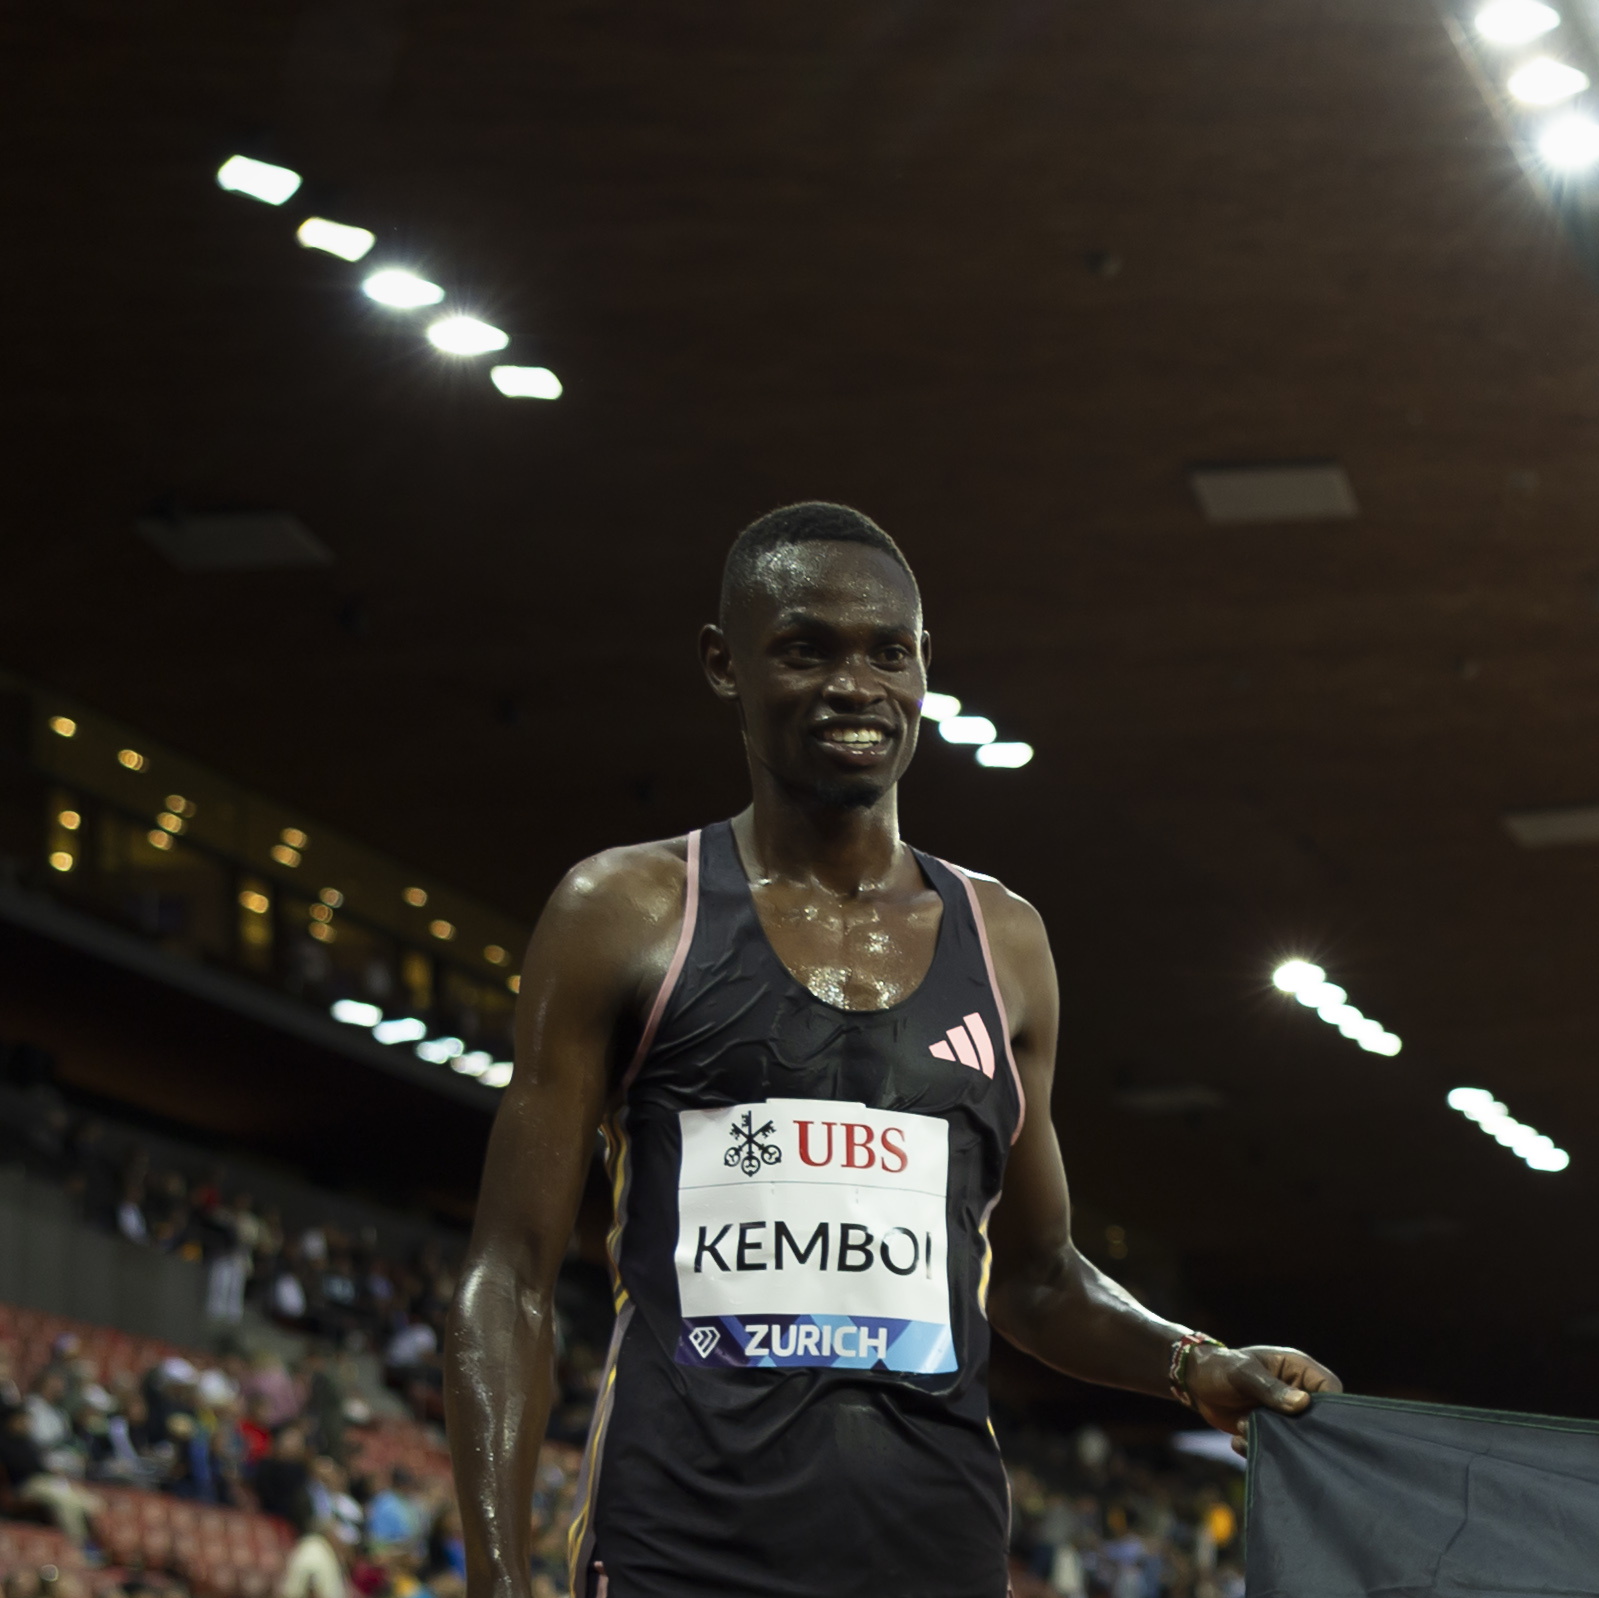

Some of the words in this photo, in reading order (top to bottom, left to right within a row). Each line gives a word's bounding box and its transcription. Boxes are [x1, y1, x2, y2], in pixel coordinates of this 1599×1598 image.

[793, 1120, 908, 1173] UBS
[693, 1220, 933, 1280] KEMBOI
[744, 1323, 889, 1359] ZURICH
